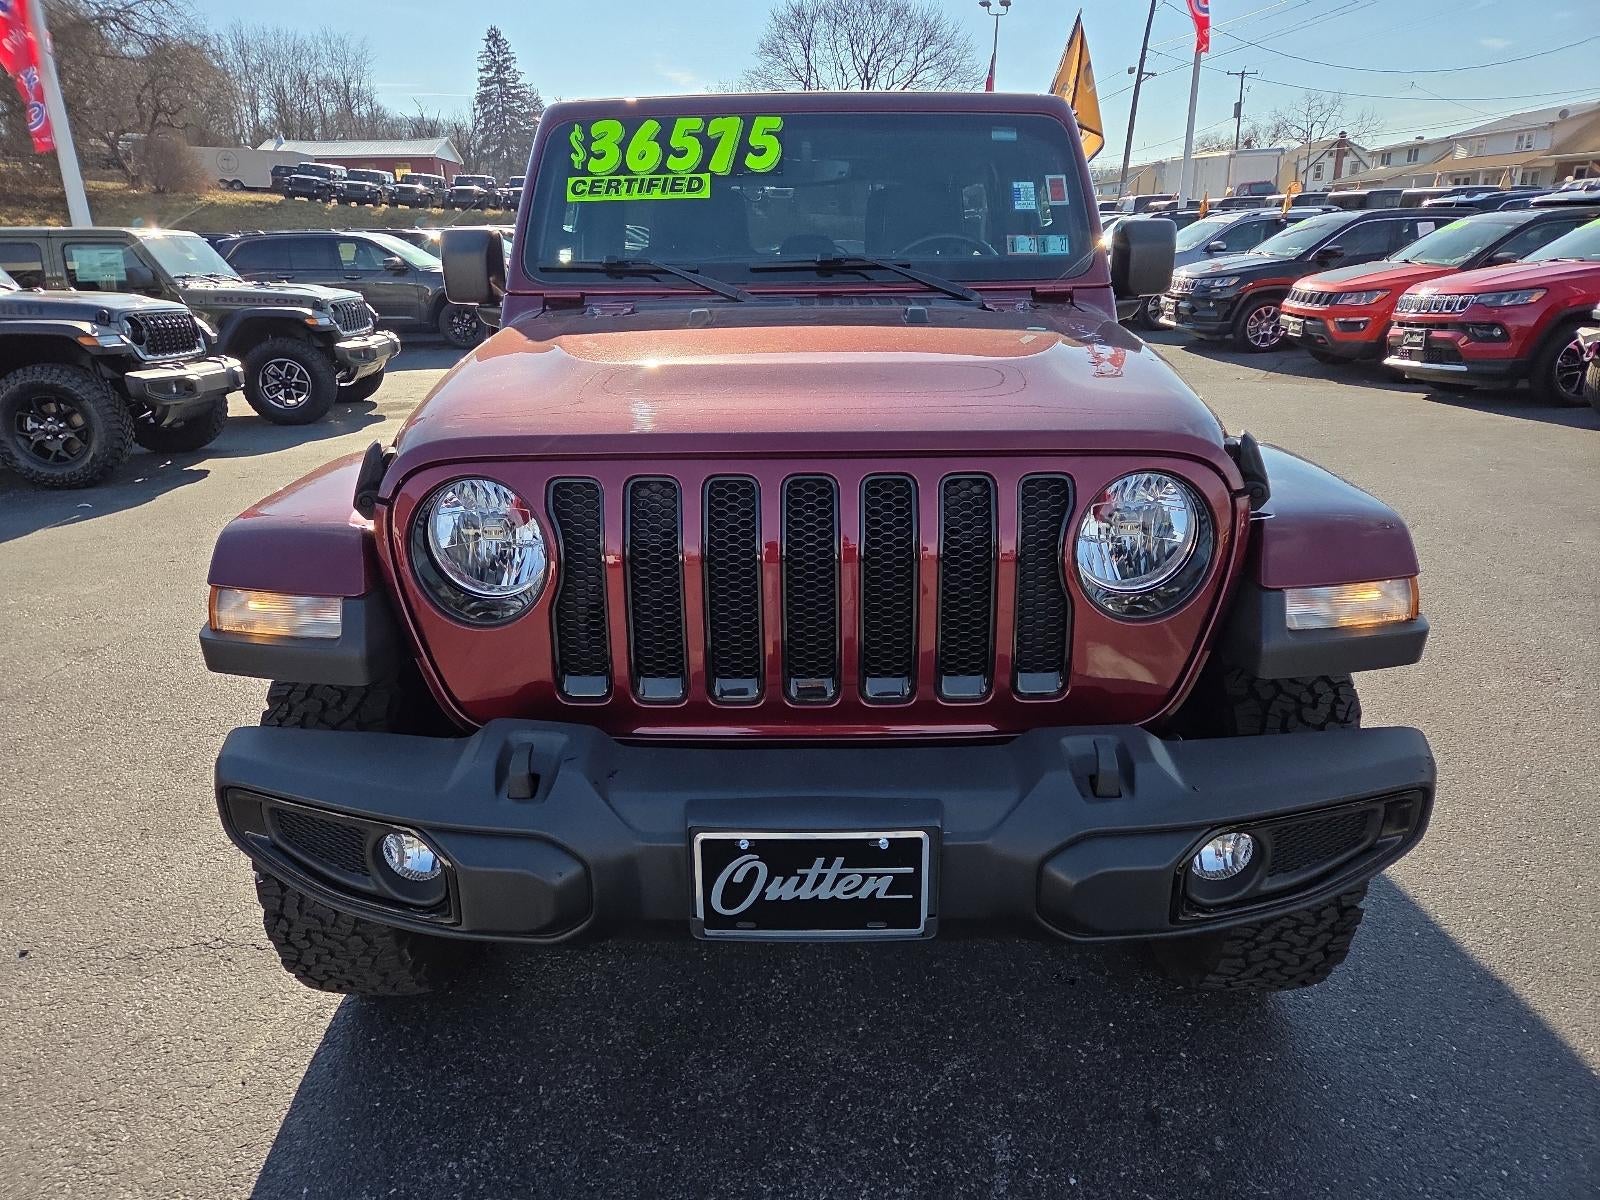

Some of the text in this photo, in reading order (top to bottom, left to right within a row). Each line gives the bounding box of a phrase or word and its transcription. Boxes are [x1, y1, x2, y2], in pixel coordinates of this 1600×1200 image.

[569, 116, 784, 175] $36575
[570, 176, 706, 197] CERTIFIED
[214, 296, 304, 305] RUBICON
[711, 855, 914, 915] Outten
